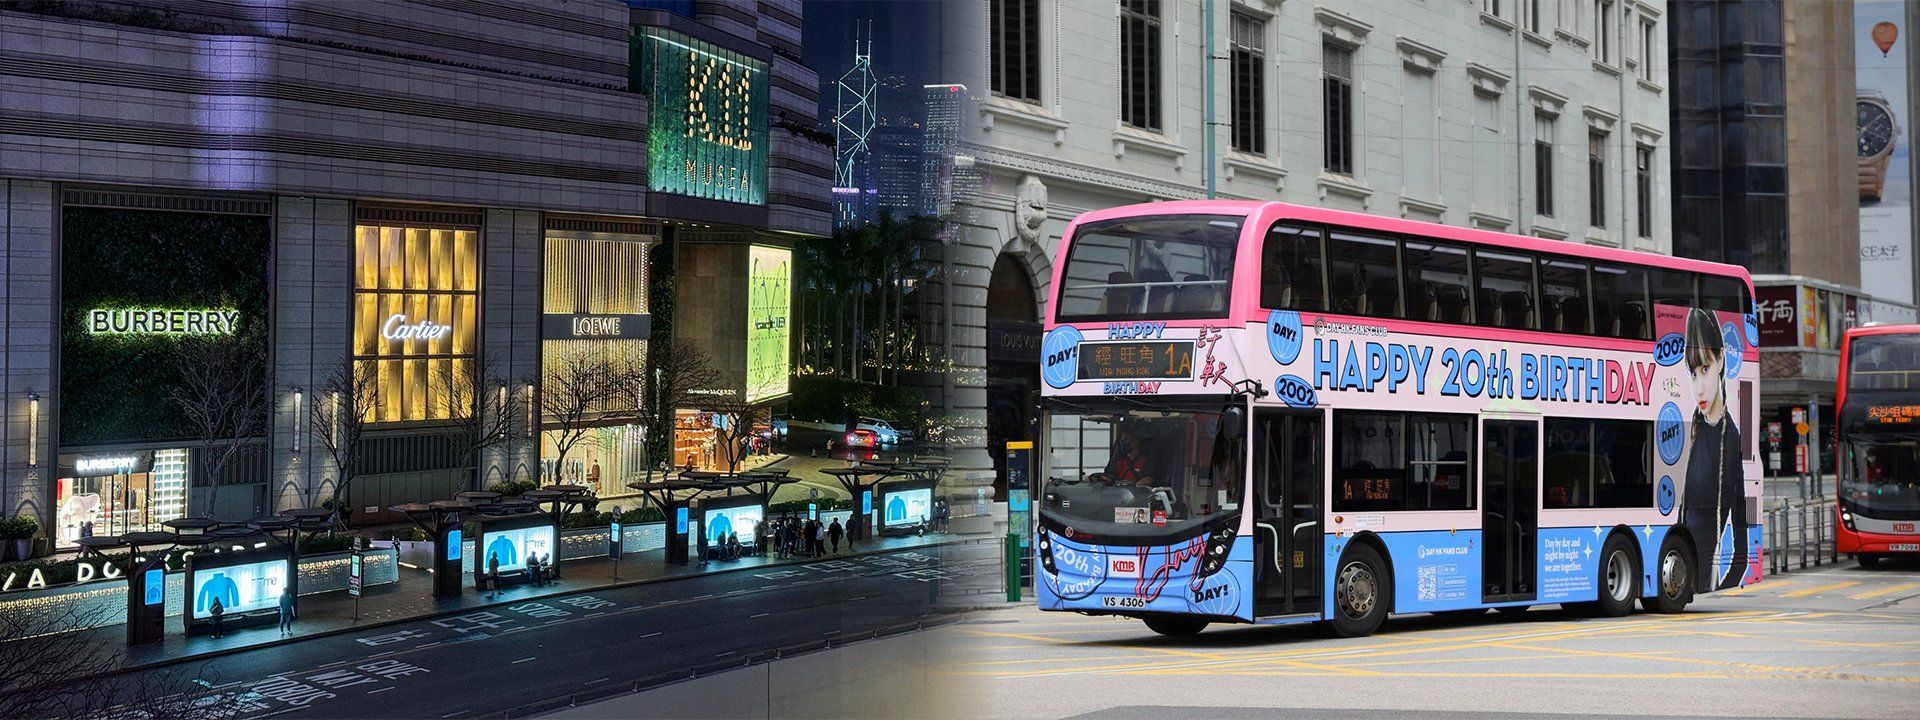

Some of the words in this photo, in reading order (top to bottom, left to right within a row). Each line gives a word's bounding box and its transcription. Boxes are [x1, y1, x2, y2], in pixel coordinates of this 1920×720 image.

[687, 51, 752, 151] K11
[685, 158, 749, 192] MUSEA
[89, 309, 239, 334] BURBERRY
[382, 313, 450, 339] Cartier
[573, 317, 621, 336] LOEWE
[1108, 322, 1167, 340] HAPPY
[1326, 322, 1340, 334] DAY
[1341, 323, 1351, 335] HK
[1351, 324, 1369, 336] FANS
[1370, 325, 1388, 337] CLUB
[1273, 322, 1297, 342] DAY!
[1048, 345, 1077, 367] DAY!
[1095, 346, 1112, 365] 經
[1120, 345, 1154, 364] 旺角
[1656, 337, 1685, 360] 2002
[1164, 343, 1192, 375] 1A
[1099, 367, 1113, 376] VIA
[1116, 367, 1135, 376] MONG
[1136, 366, 1150, 376] KOK
[1313, 338, 1434, 395] HAPPY
[1440, 347, 1514, 400] 20th
[1520, 352, 1656, 406] BIRTHDAY
[1103, 381, 1161, 395] BIRTHDAY
[1278, 377, 1314, 406] 2002
[1661, 423, 1680, 443] DAY!
[1892, 522, 1915, 533] KMB
[1425, 548, 1435, 556] DAY
[1442, 547, 1455, 555] FANS
[1455, 546, 1468, 555] CLUB
[1544, 538, 1555, 551] Day
[1562, 537, 1571, 551] day
[1571, 537, 1580, 547] and
[1055, 543, 1089, 574] 20th
[1544, 550, 1558, 562] night
[1558, 551, 1565, 562] by
[1565, 549, 1579, 562] night
[1112, 560, 1136, 573] KMB
[1552, 564, 1560, 572] are
[1560, 561, 1582, 574] together.
[559, 595, 617, 609] BUS
[1103, 596, 1116, 607] VS
[1119, 596, 1144, 608] 4306
[1194, 584, 1229, 604] DAY!
[508, 603, 572, 618] STOP
[305, 669, 378, 689] WAY
[356, 659, 431, 680] GIVE
